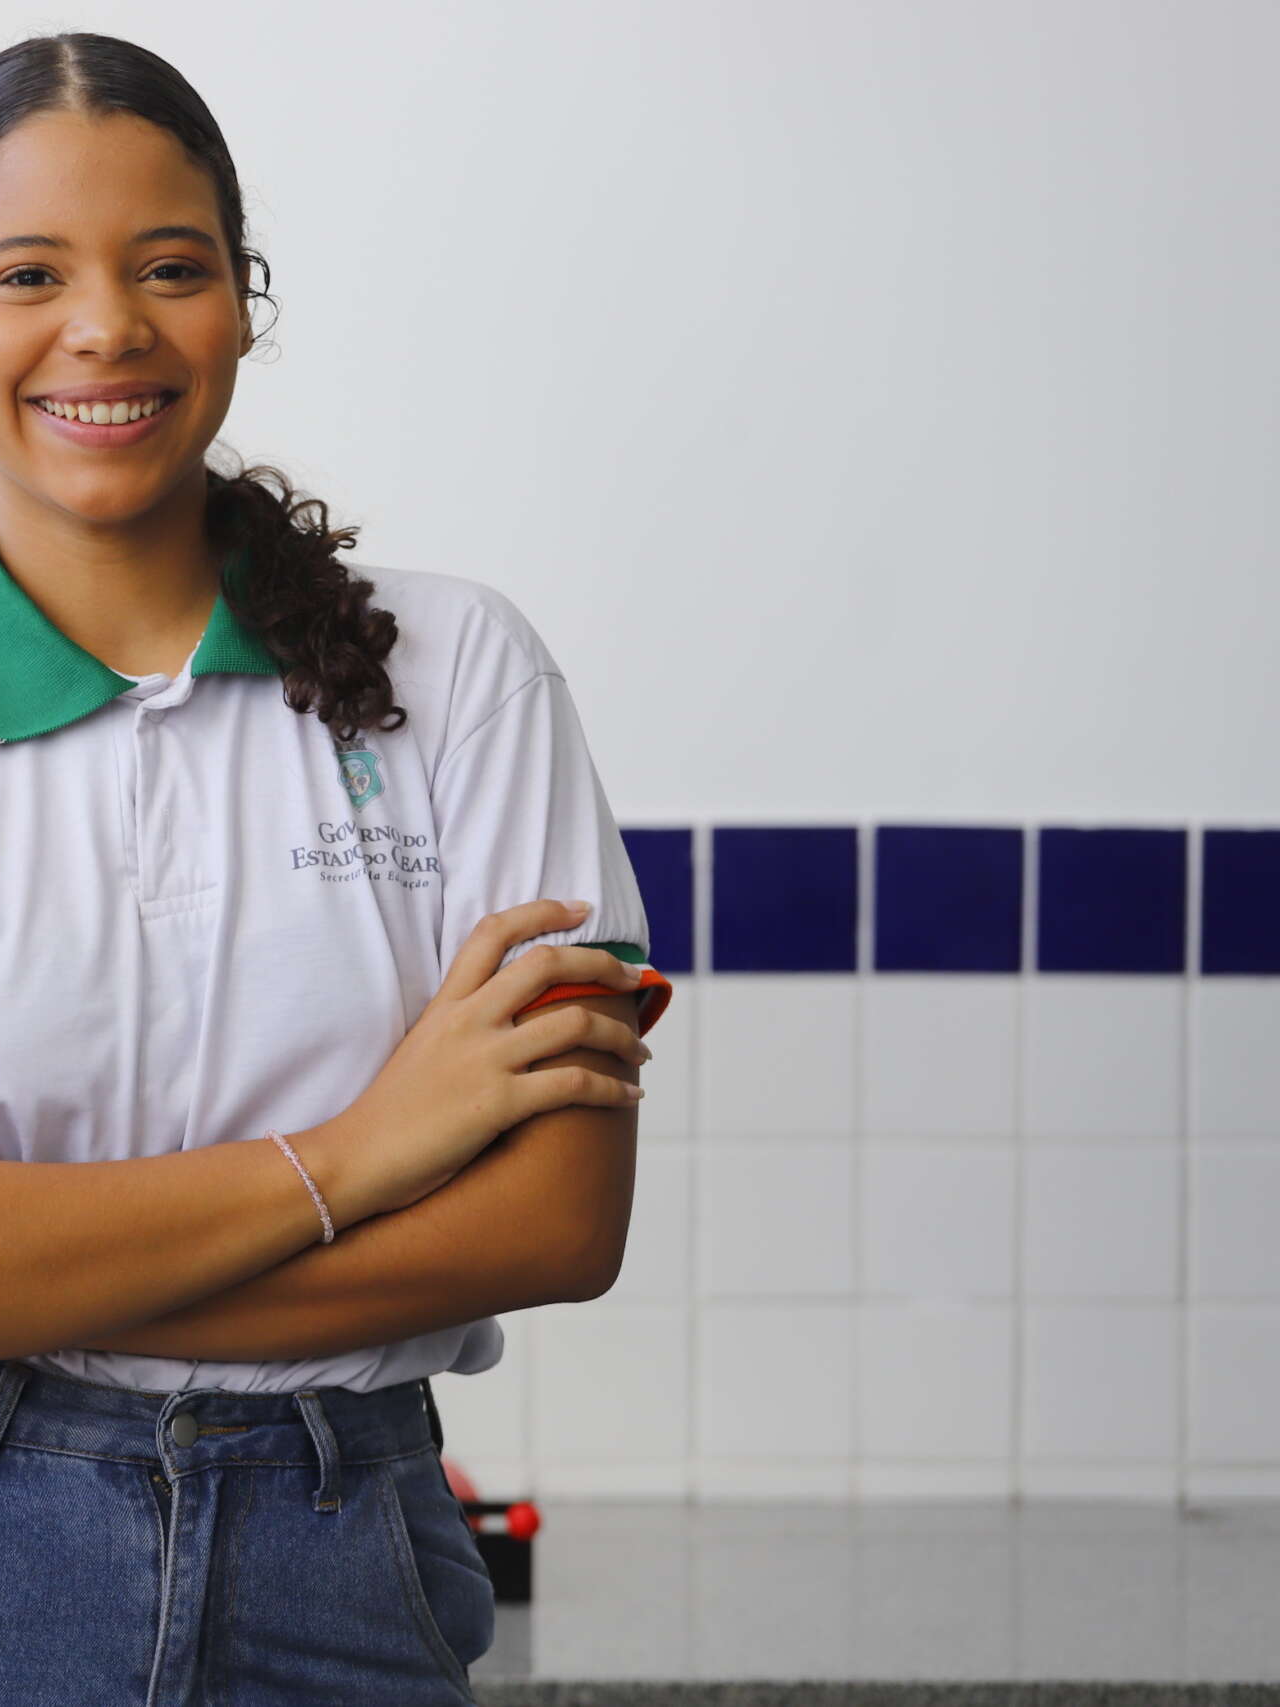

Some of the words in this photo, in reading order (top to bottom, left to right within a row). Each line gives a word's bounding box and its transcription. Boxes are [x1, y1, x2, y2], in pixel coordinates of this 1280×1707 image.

[318, 820, 400, 843] GOVRNO
[403, 835, 427, 848] DO
[391, 845, 440, 873] CEAR
